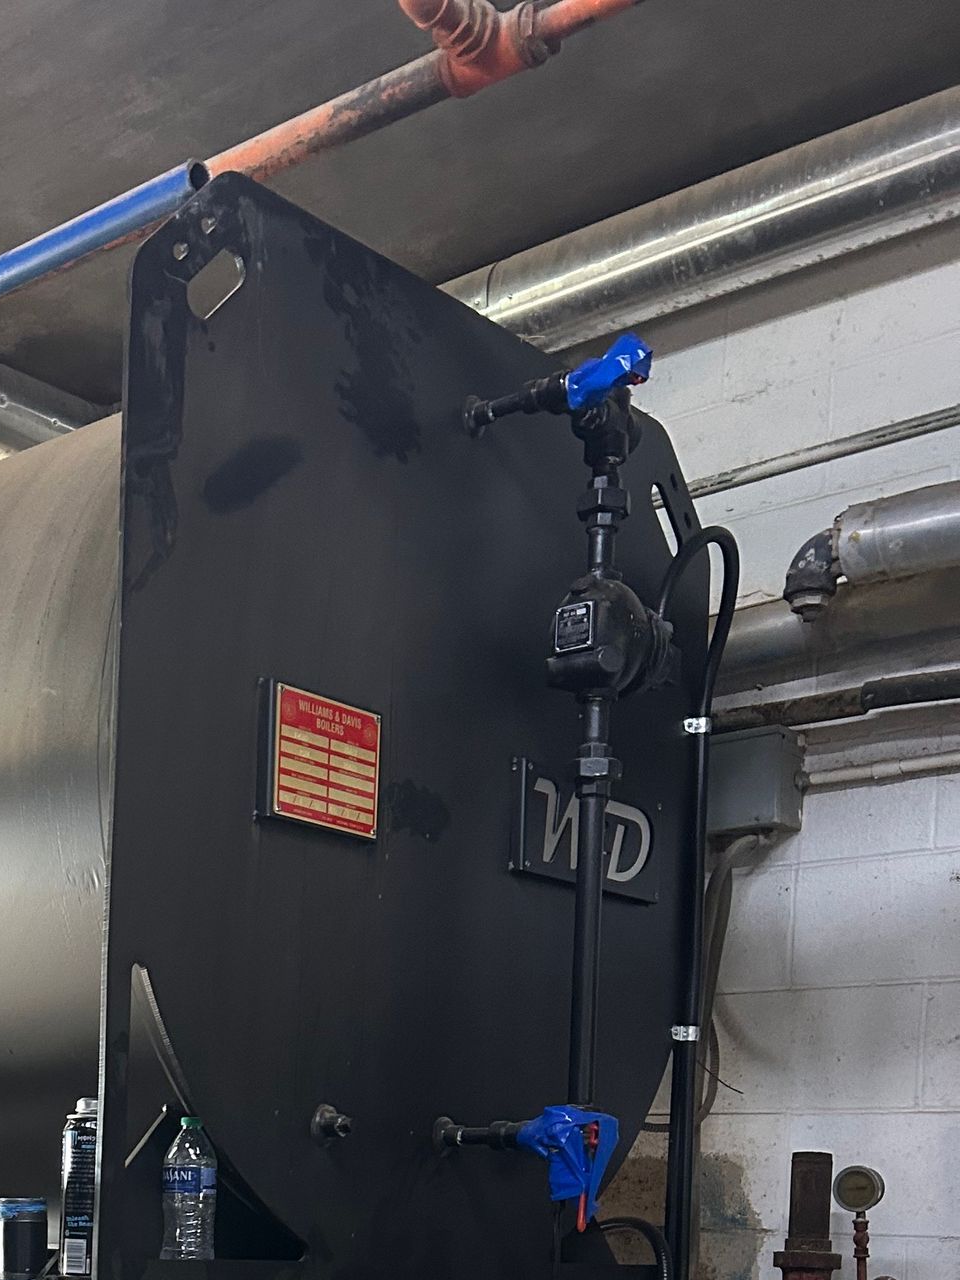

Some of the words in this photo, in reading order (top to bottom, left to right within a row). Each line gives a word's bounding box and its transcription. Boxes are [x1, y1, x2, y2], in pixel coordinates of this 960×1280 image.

[299, 699, 333, 720] WILLIAMS
[335, 711, 340, 722] &
[342, 713, 362, 729] DAVIS
[316, 718, 344, 736] BOILERS
[164, 1168, 192, 1183] ASANI
